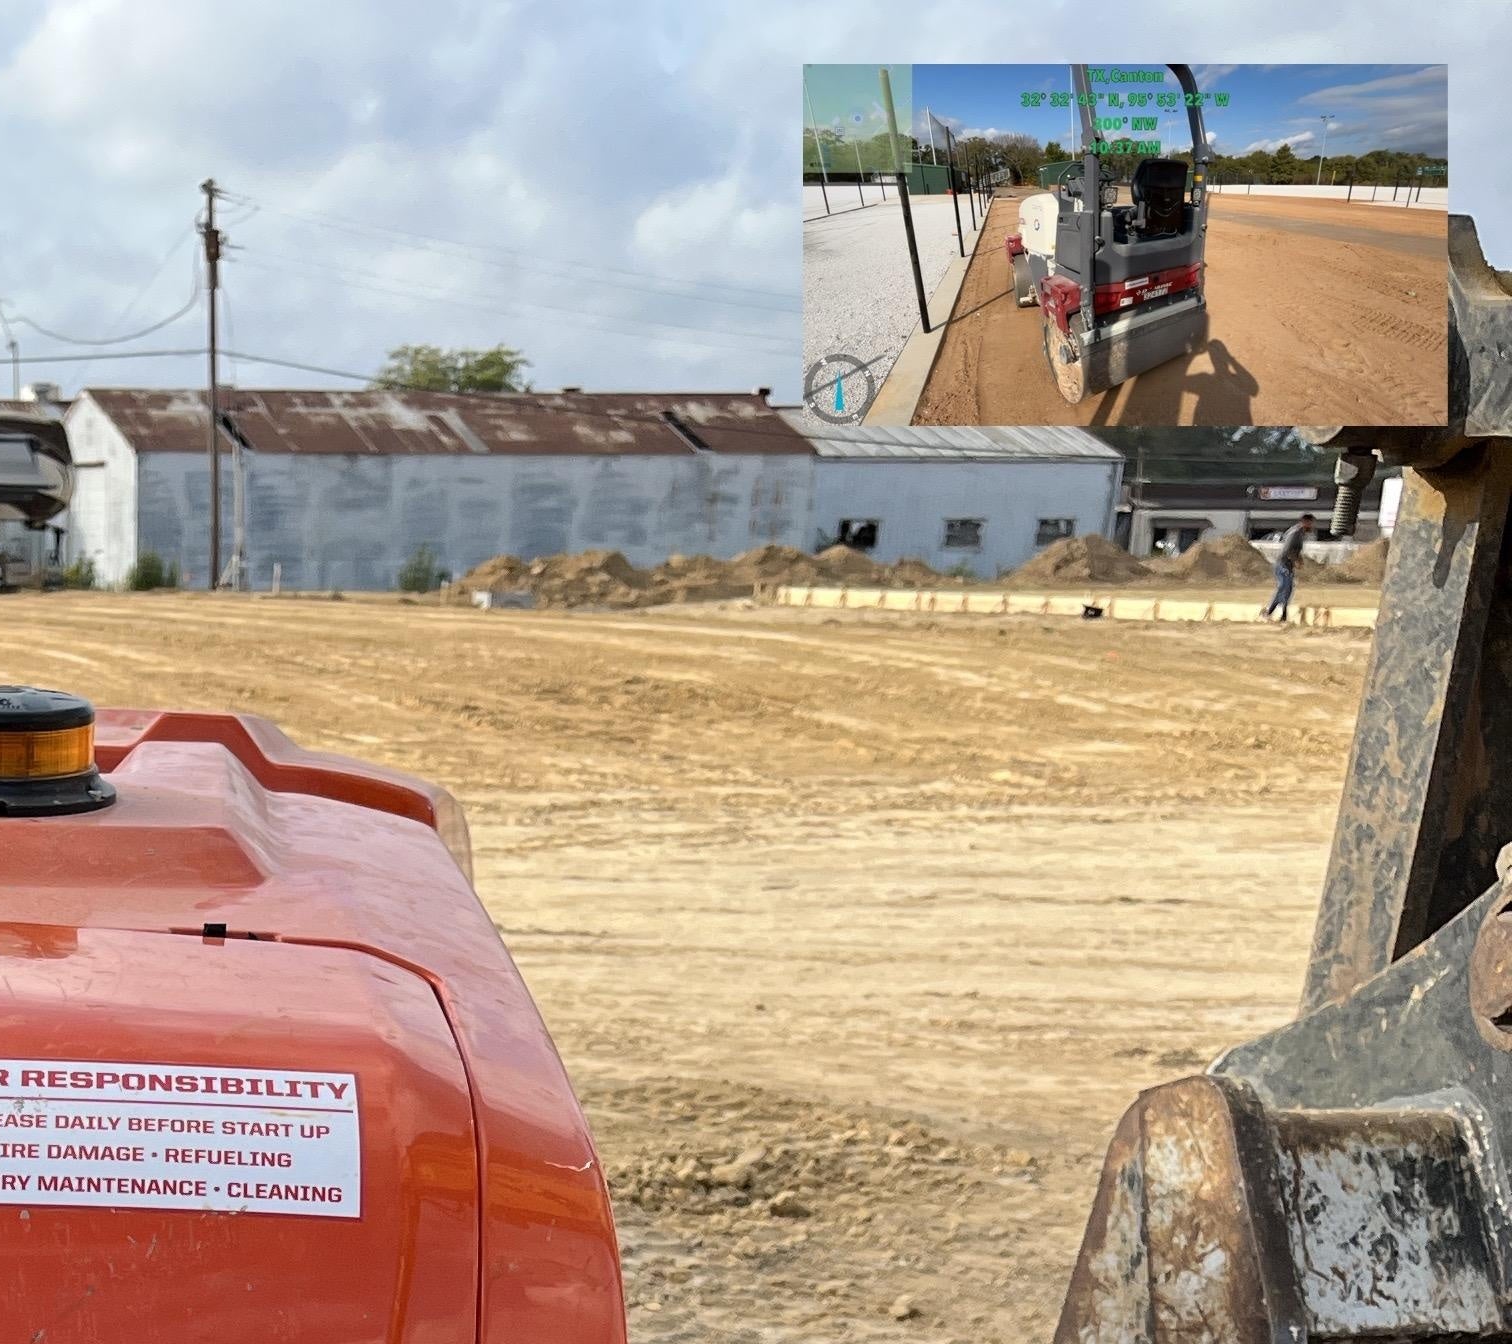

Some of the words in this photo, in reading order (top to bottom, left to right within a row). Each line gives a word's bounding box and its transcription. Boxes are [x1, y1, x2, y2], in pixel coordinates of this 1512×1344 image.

[21, 1068, 350, 1100] RESPONSIBILITY
[55, 1116, 122, 1131] DAILY
[128, 1118, 215, 1135] BEFORE
[221, 1121, 294, 1138] START
[299, 1125, 331, 1139] UP
[46, 1145, 145, 1163] DAMAGE
[164, 1149, 292, 1168] REFUELING
[37, 1176, 208, 1197] MAINTENANCE
[227, 1182, 343, 1203] CLEANING
